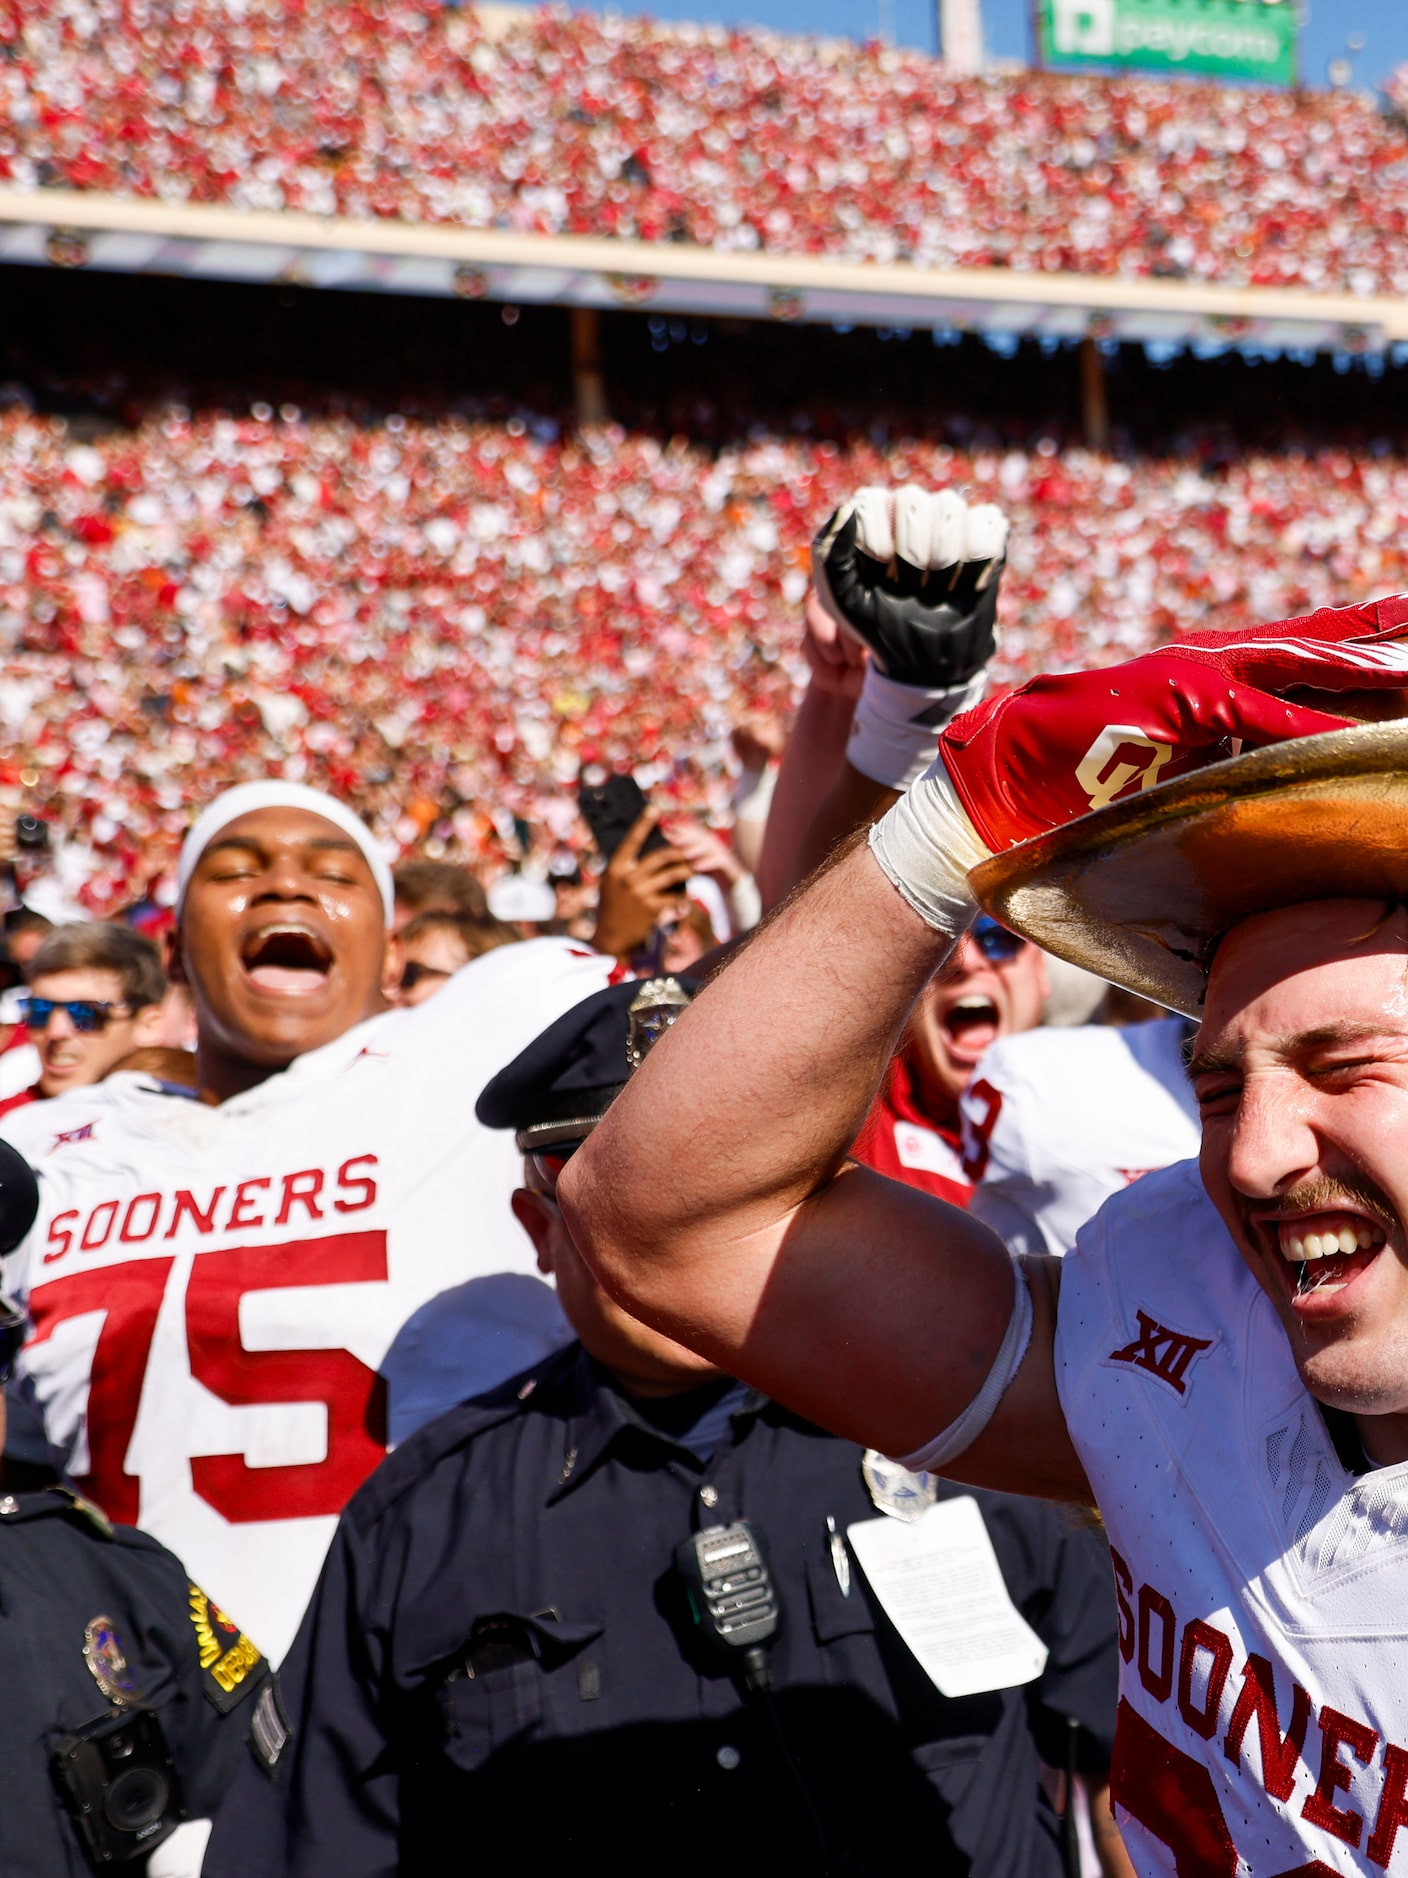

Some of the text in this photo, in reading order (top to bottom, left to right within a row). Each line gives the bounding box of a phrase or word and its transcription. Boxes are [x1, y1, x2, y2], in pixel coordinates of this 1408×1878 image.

[43, 1152, 379, 1265] SOONERS
[22, 1229, 389, 1526] 75
[1108, 1308, 1214, 1396] XII
